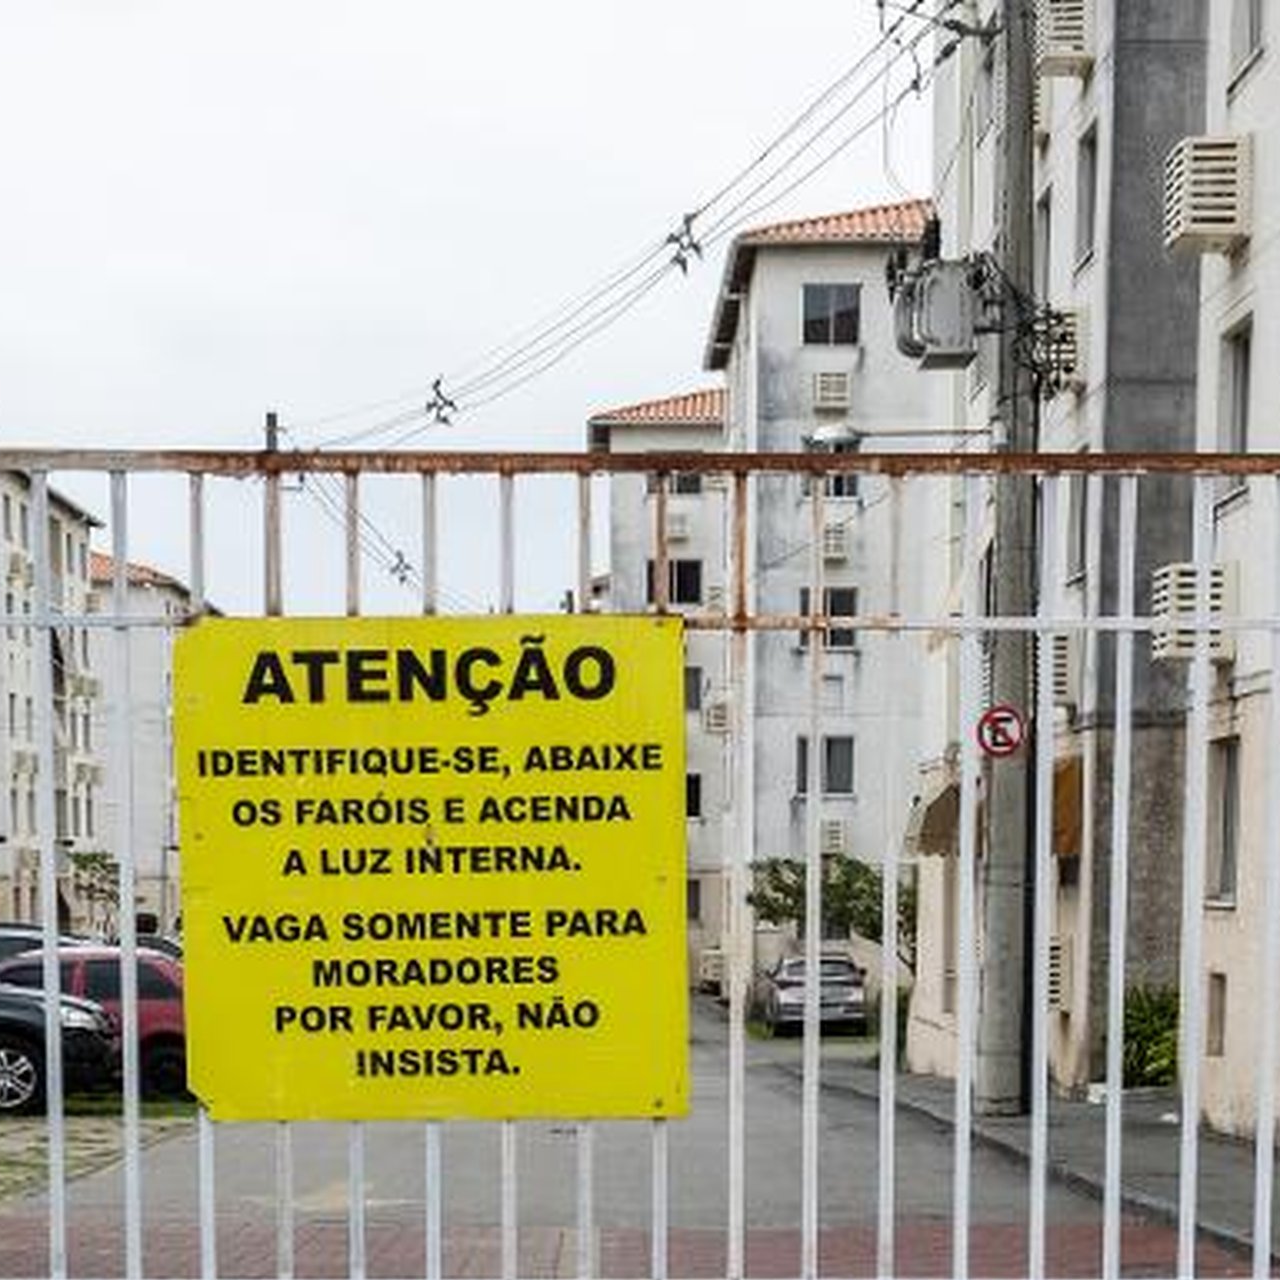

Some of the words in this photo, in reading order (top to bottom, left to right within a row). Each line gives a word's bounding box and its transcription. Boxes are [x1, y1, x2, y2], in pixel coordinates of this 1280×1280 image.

[242, 635, 616, 717] ATENÇÃO
[198, 746, 510, 778] IDENTIFIQUE-SE,
[523, 744, 662, 772] ABAIXE
[232, 799, 282, 827] OS
[296, 792, 430, 827] FARÓIS
[444, 798, 465, 824] E
[479, 795, 631, 823] ACENDA
[282, 850, 307, 876] A
[321, 848, 392, 875] LUZ
[406, 845, 581, 874] INTERNA.
[222, 914, 329, 943] VAGA
[343, 911, 531, 941] SOMENTE
[546, 909, 647, 937] PARA
[313, 956, 560, 987] MORADORES
[276, 1006, 353, 1033] POR
[368, 1003, 503, 1036] FAVOR,
[517, 996, 599, 1029] NÃO
[357, 1049, 520, 1077] INSISTA.
